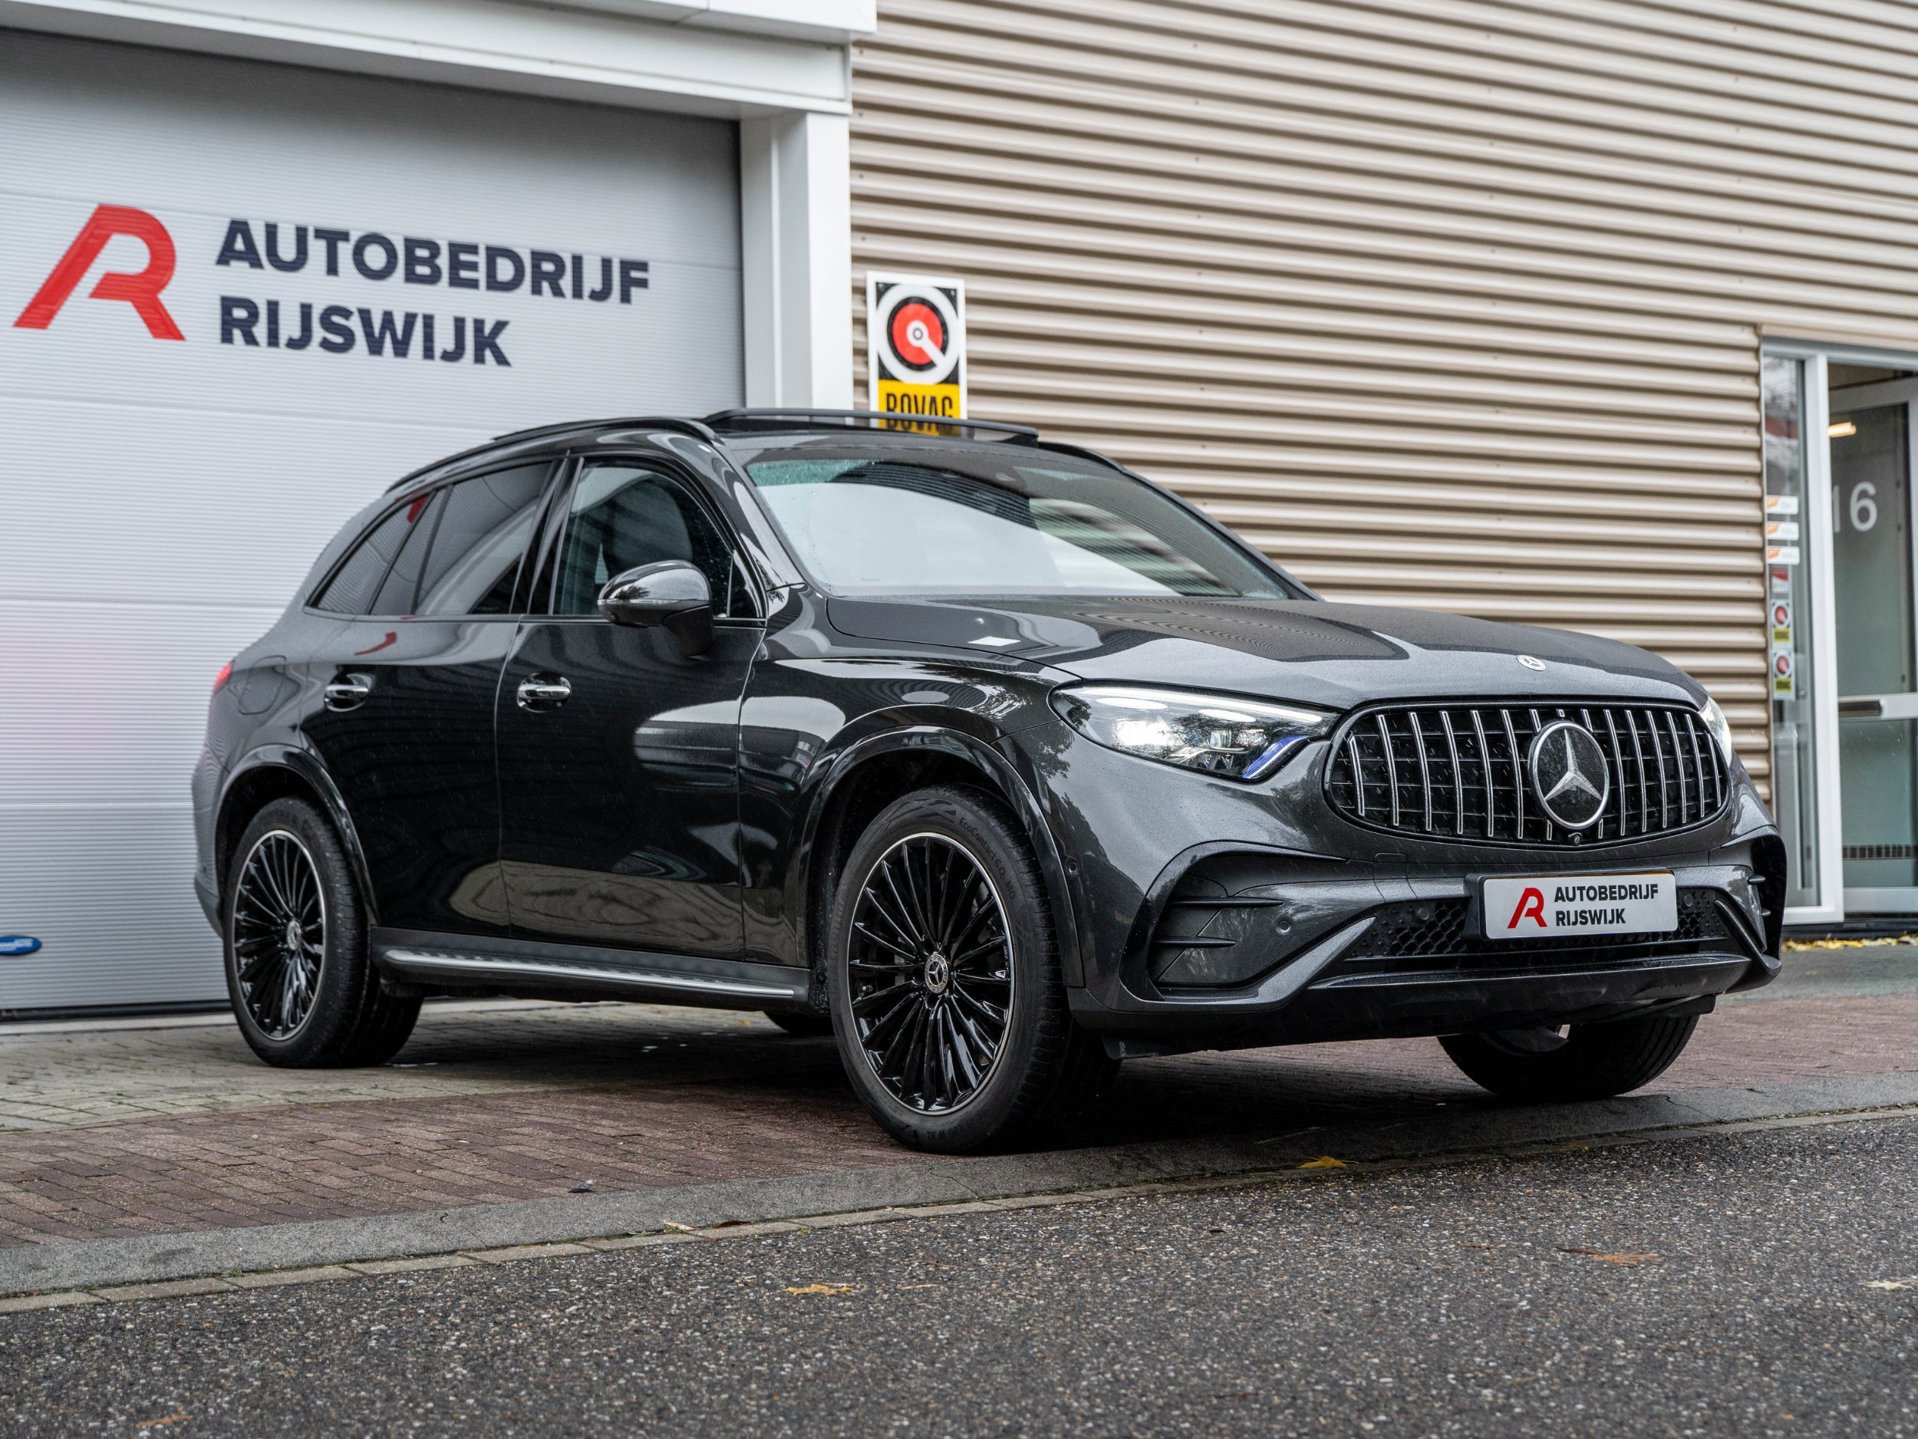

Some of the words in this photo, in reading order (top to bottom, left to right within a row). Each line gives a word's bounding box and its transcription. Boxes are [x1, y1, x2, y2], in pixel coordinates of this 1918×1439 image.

[216, 217, 649, 305] AUTOBEDRIJF
[220, 295, 512, 367] RIJSWIJK
[1554, 884, 1659, 902] AUTOBEDRIJF
[1555, 908, 1626, 927] RIJSWIJK
